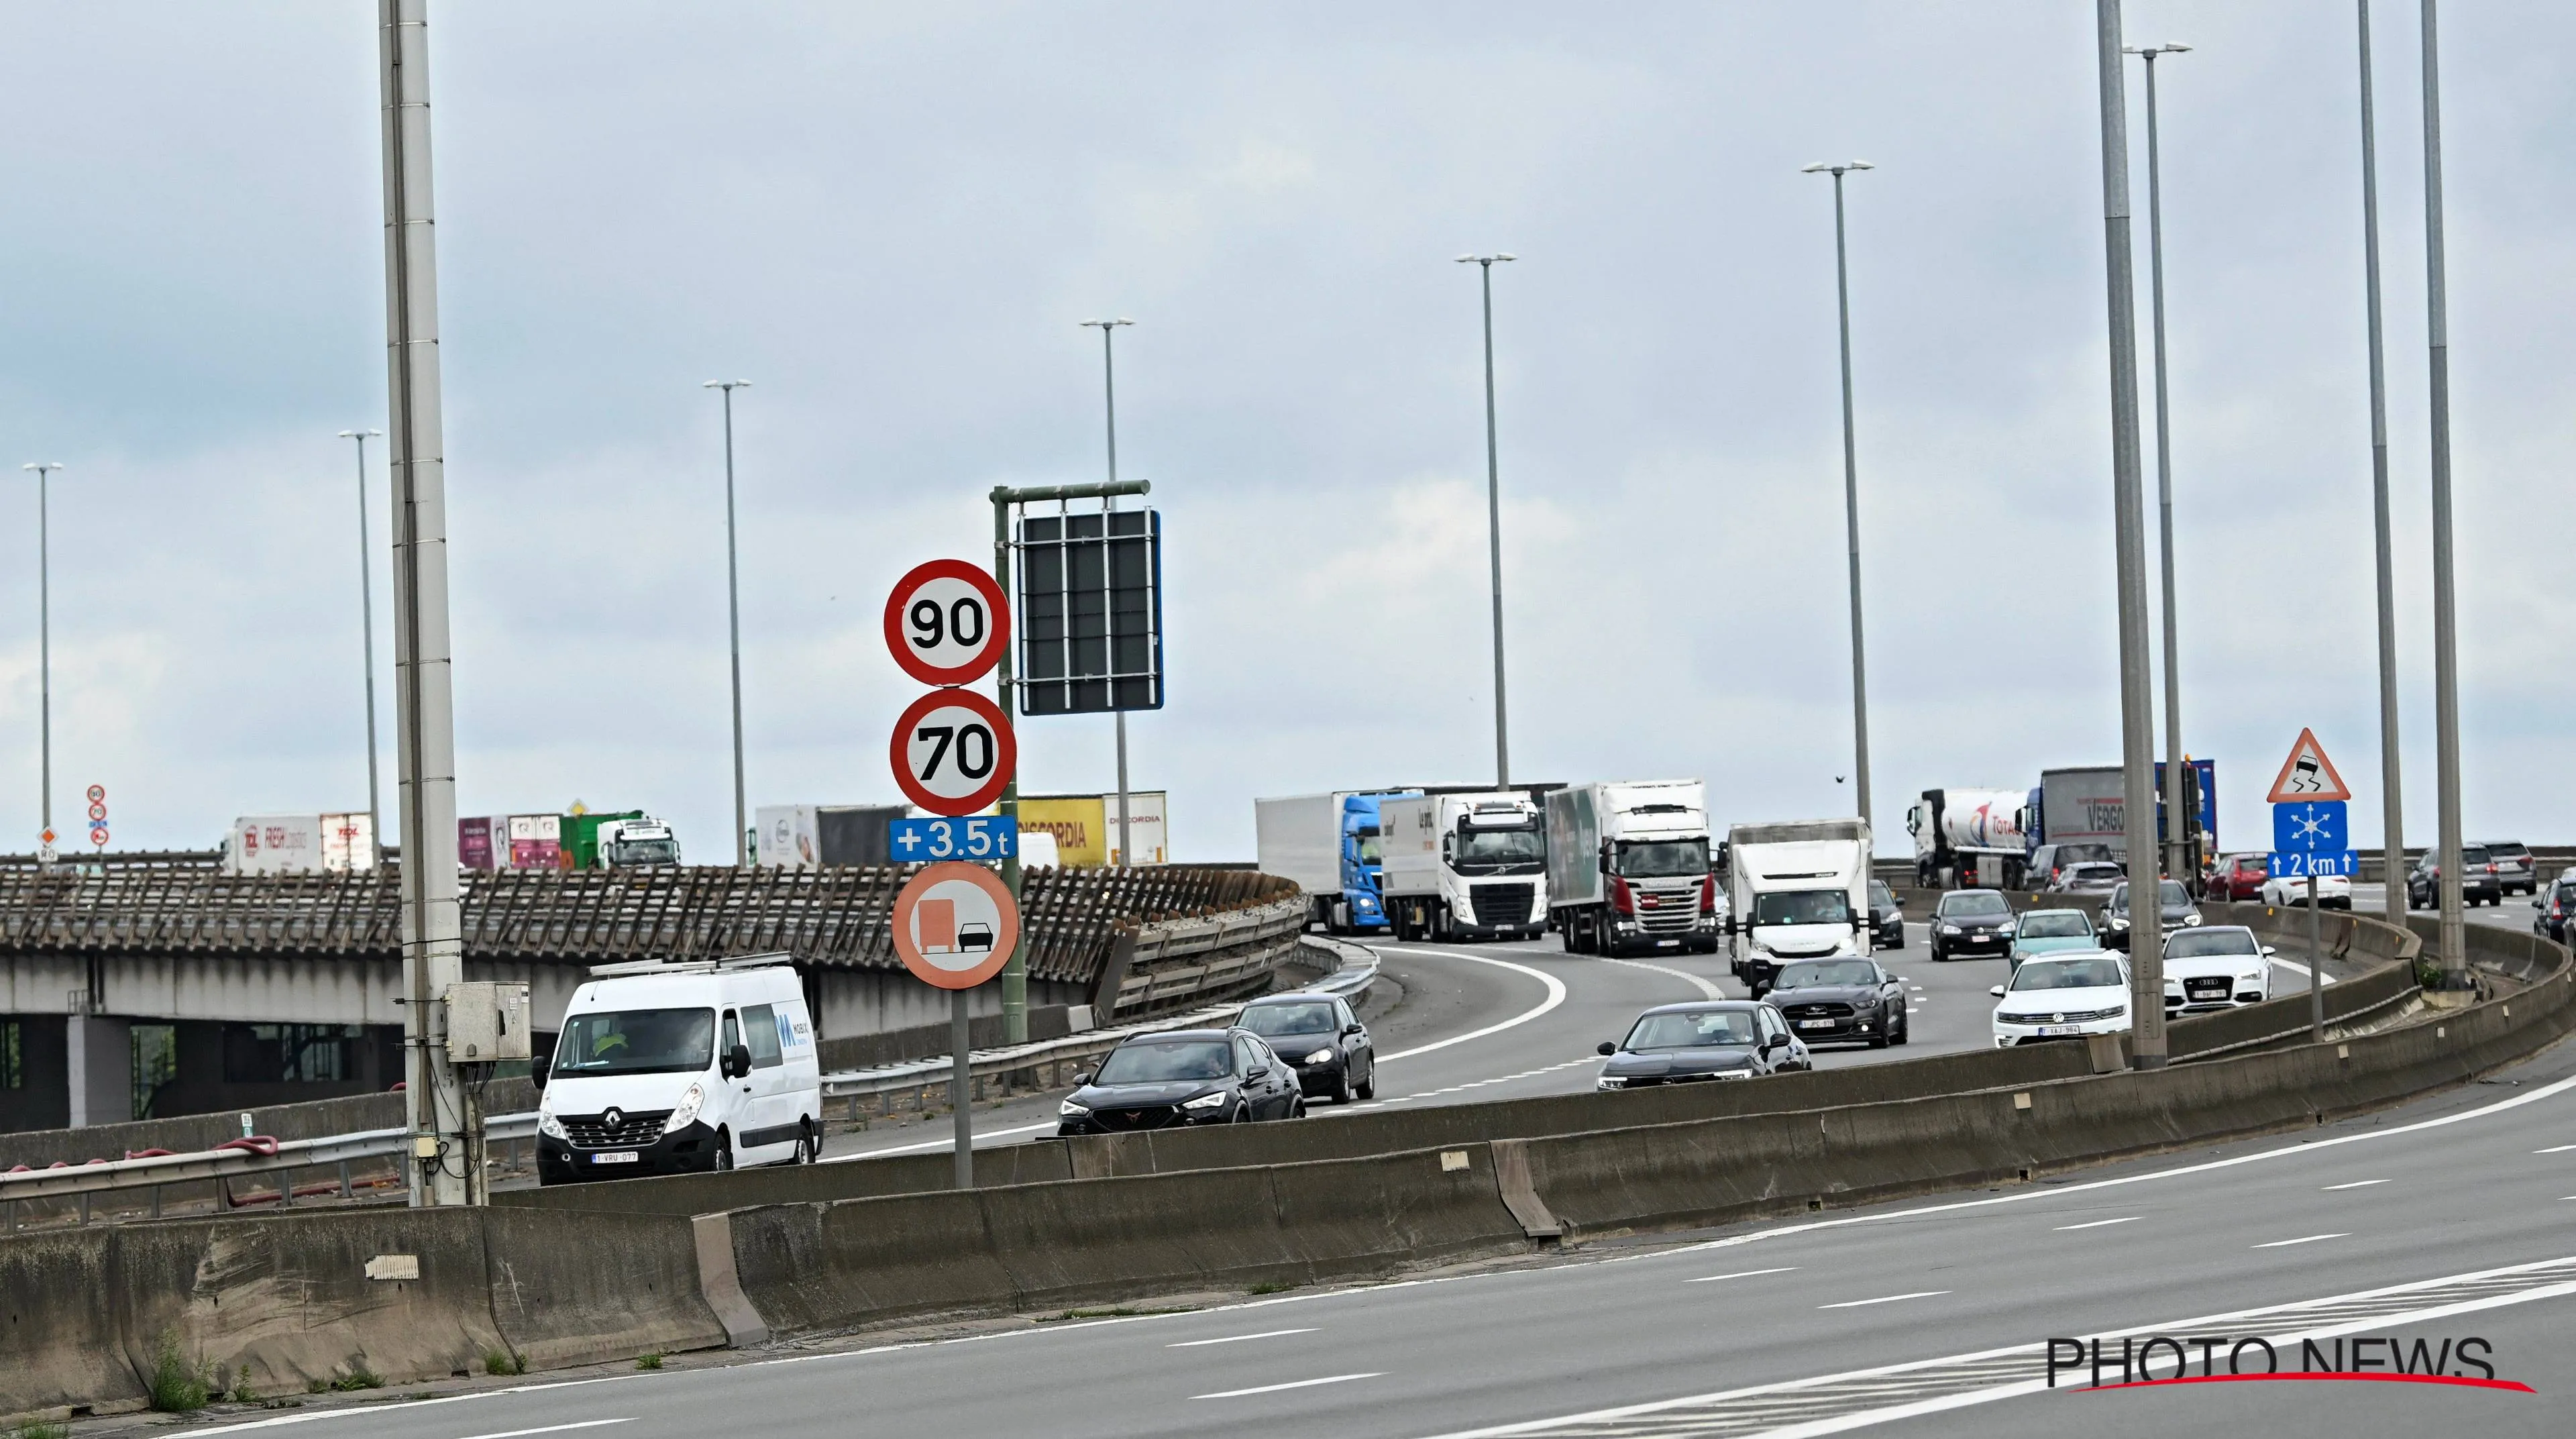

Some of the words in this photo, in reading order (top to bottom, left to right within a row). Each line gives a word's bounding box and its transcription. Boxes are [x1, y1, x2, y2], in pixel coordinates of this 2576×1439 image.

[910, 597, 984, 649] 90
[918, 723, 994, 781] 70
[1110, 815, 1161, 824] DICORDIA
[2290, 853, 2303, 876] 2
[2307, 853, 2336, 875] km
